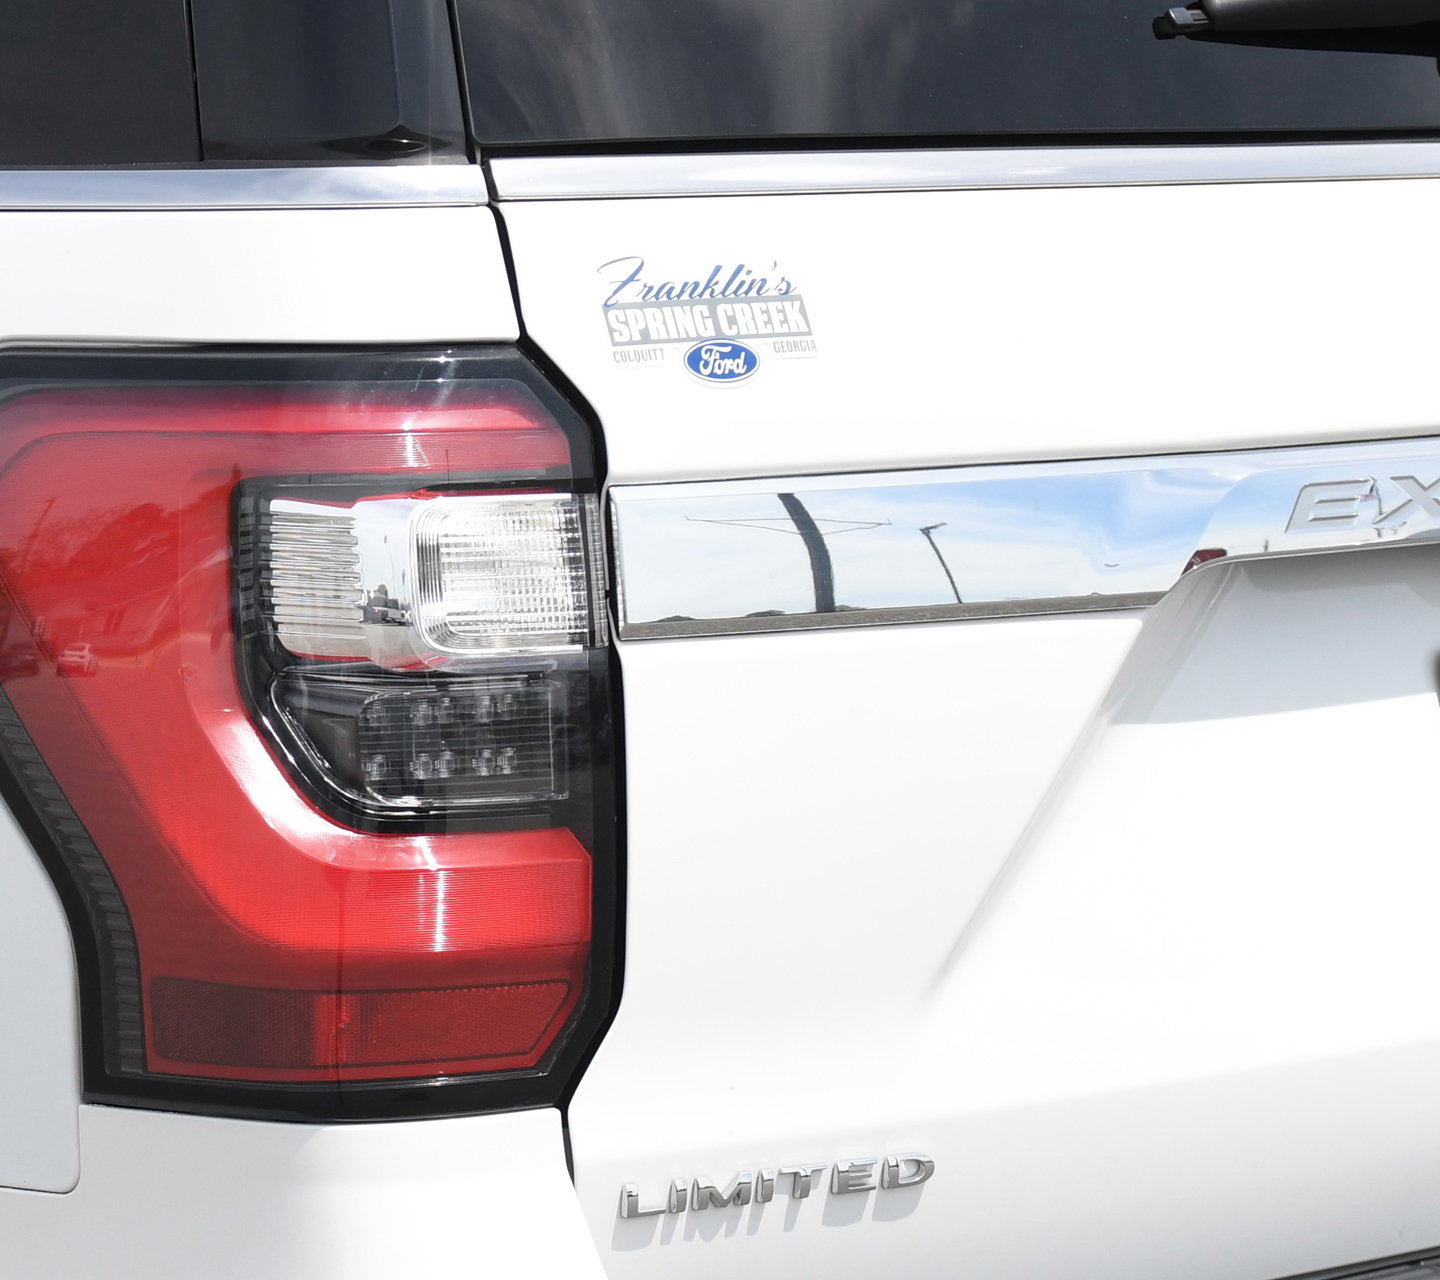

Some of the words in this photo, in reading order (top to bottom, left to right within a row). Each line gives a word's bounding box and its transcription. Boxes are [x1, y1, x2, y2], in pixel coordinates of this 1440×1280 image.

[596, 255, 798, 308] Franklin's
[606, 304, 717, 344] SPRING
[716, 300, 810, 337] CREEK
[612, 347, 665, 364] COLQUITT
[698, 344, 749, 377] Ford
[772, 339, 818, 354] GEORGIA
[619, 1152, 936, 1220] LIMITED
